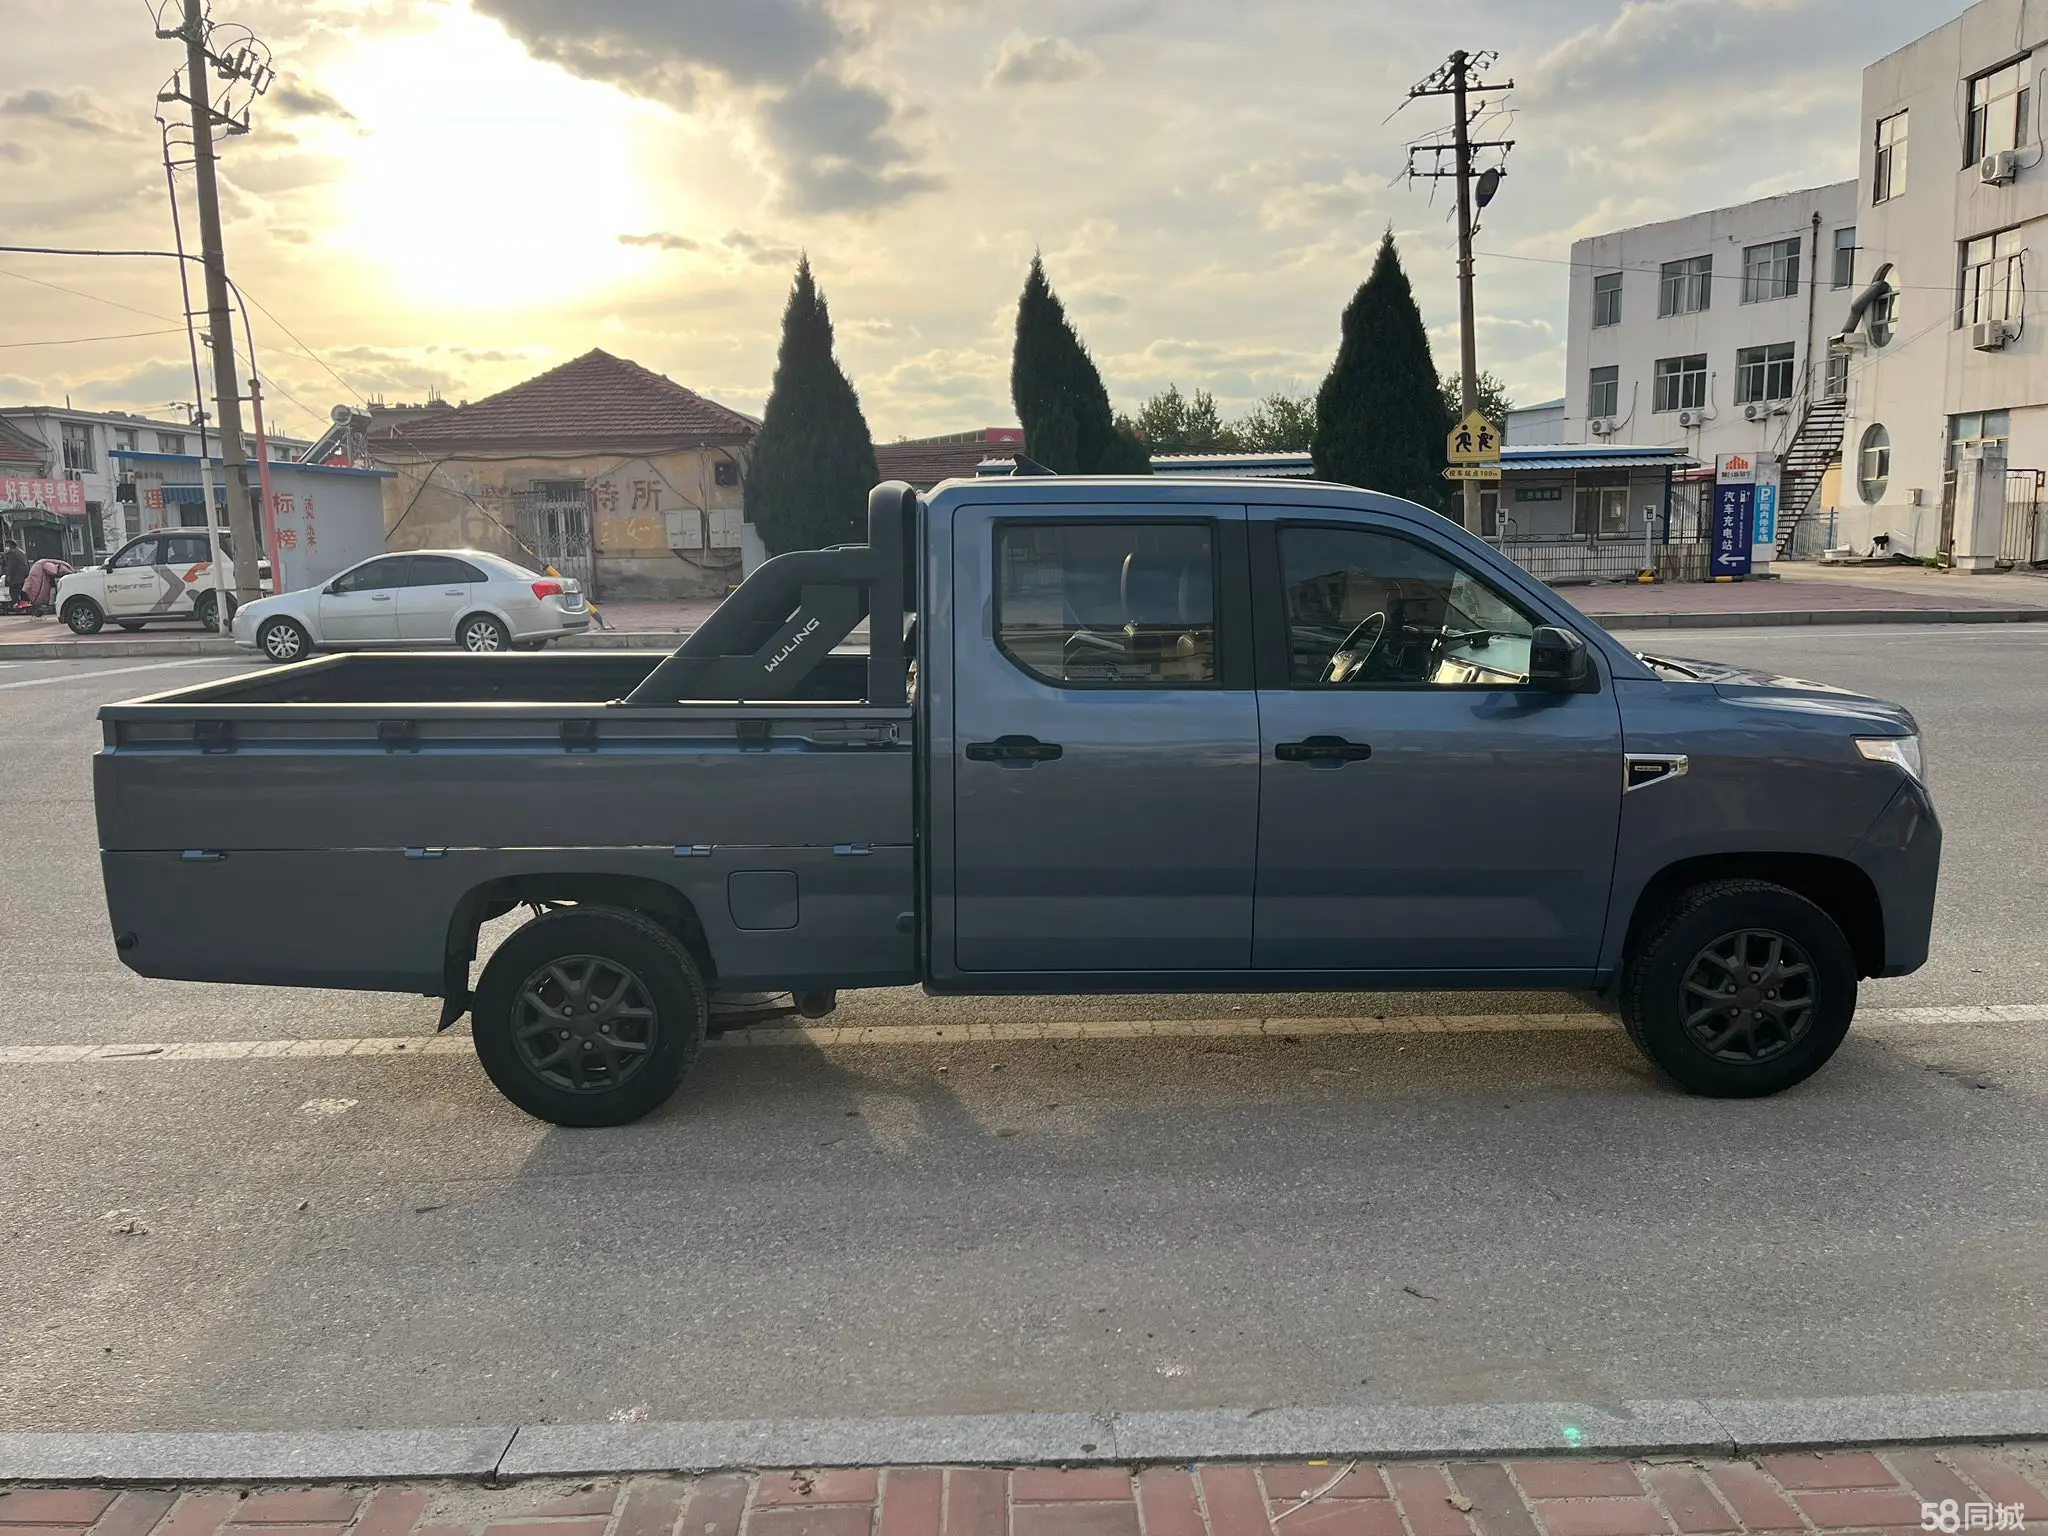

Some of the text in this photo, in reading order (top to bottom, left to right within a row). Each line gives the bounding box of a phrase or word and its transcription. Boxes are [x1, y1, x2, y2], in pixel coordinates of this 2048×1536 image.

[5, 480, 80, 504] 好再来早餐店
[1761, 488, 1771, 501] P
[273, 493, 297, 549] 标榜
[1721, 491, 1736, 551] 汽车充电站
[1758, 503, 1771, 542] 院内停车场
[764, 617, 820, 673] WULING
